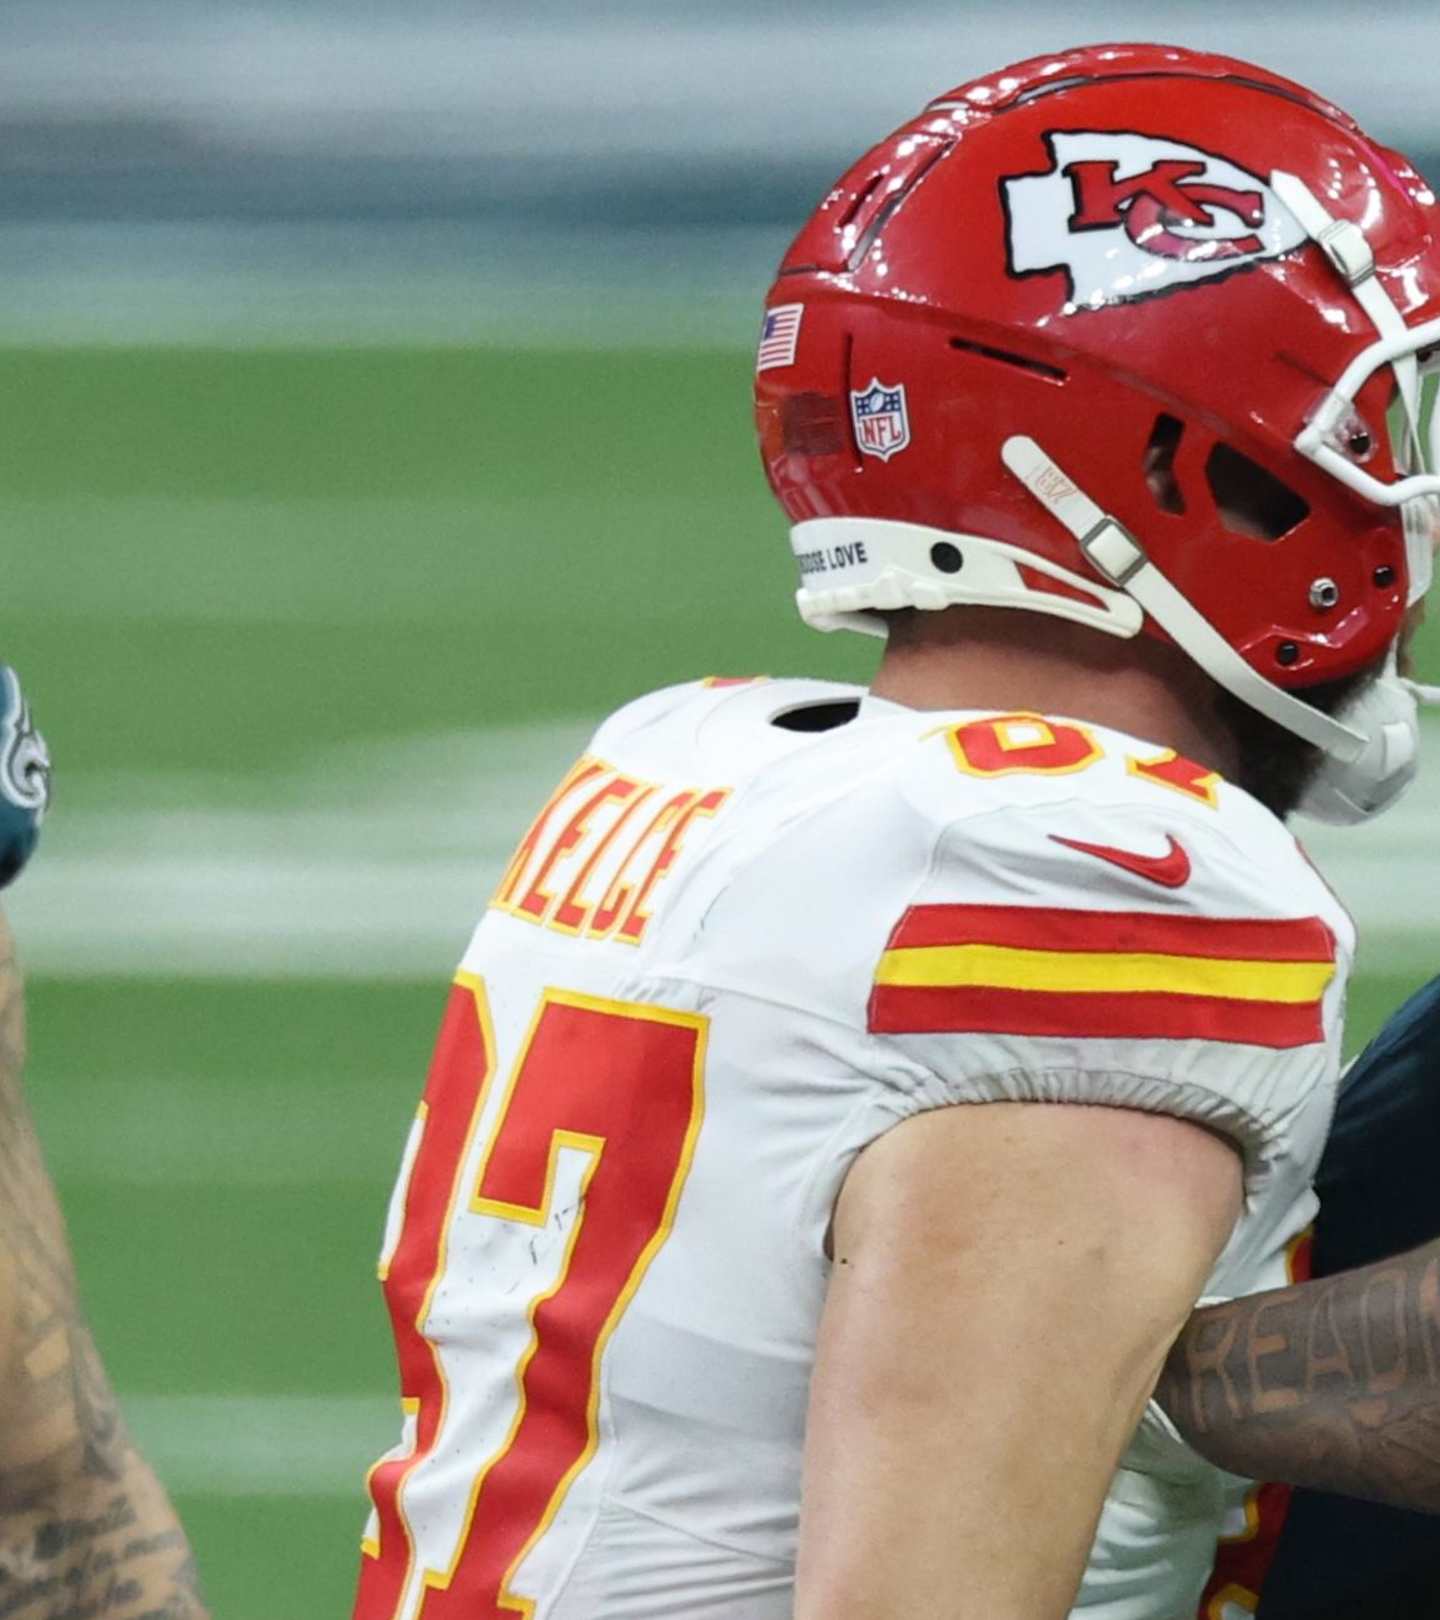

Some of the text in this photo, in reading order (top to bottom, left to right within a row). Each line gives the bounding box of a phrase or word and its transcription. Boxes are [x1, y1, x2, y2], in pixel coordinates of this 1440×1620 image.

[1062, 160, 1266, 263] KC
[861, 415, 902, 448] NFL
[827, 541, 868, 570] LOVE
